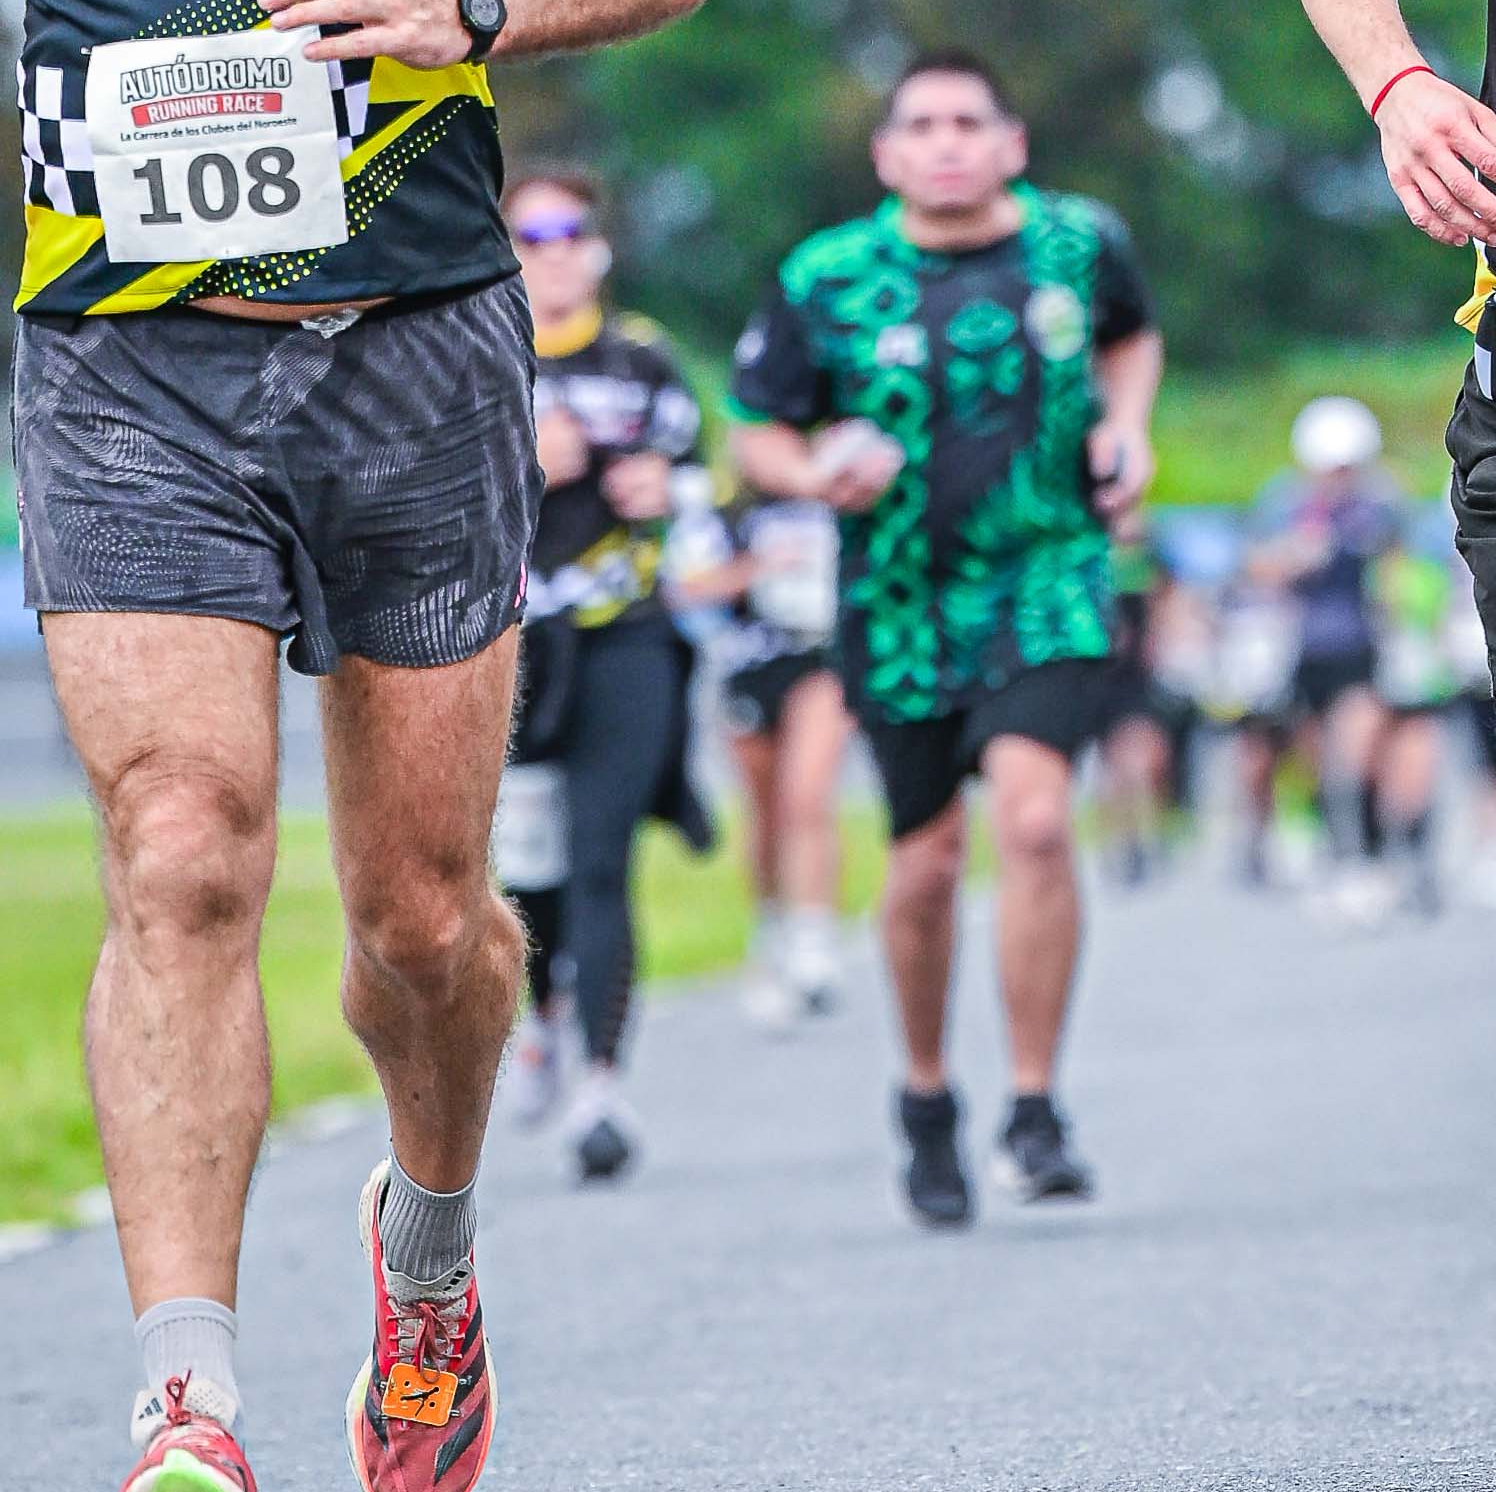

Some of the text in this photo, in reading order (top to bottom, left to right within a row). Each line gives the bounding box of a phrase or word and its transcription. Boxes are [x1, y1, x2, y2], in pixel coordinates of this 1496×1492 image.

[120, 53, 293, 104] AUTÓDROMO
[148, 93, 266, 124] RUNNING RACE
[120, 117, 298, 142] La Carrera de los Clubes del Noroeste
[133, 146, 301, 226] 108
